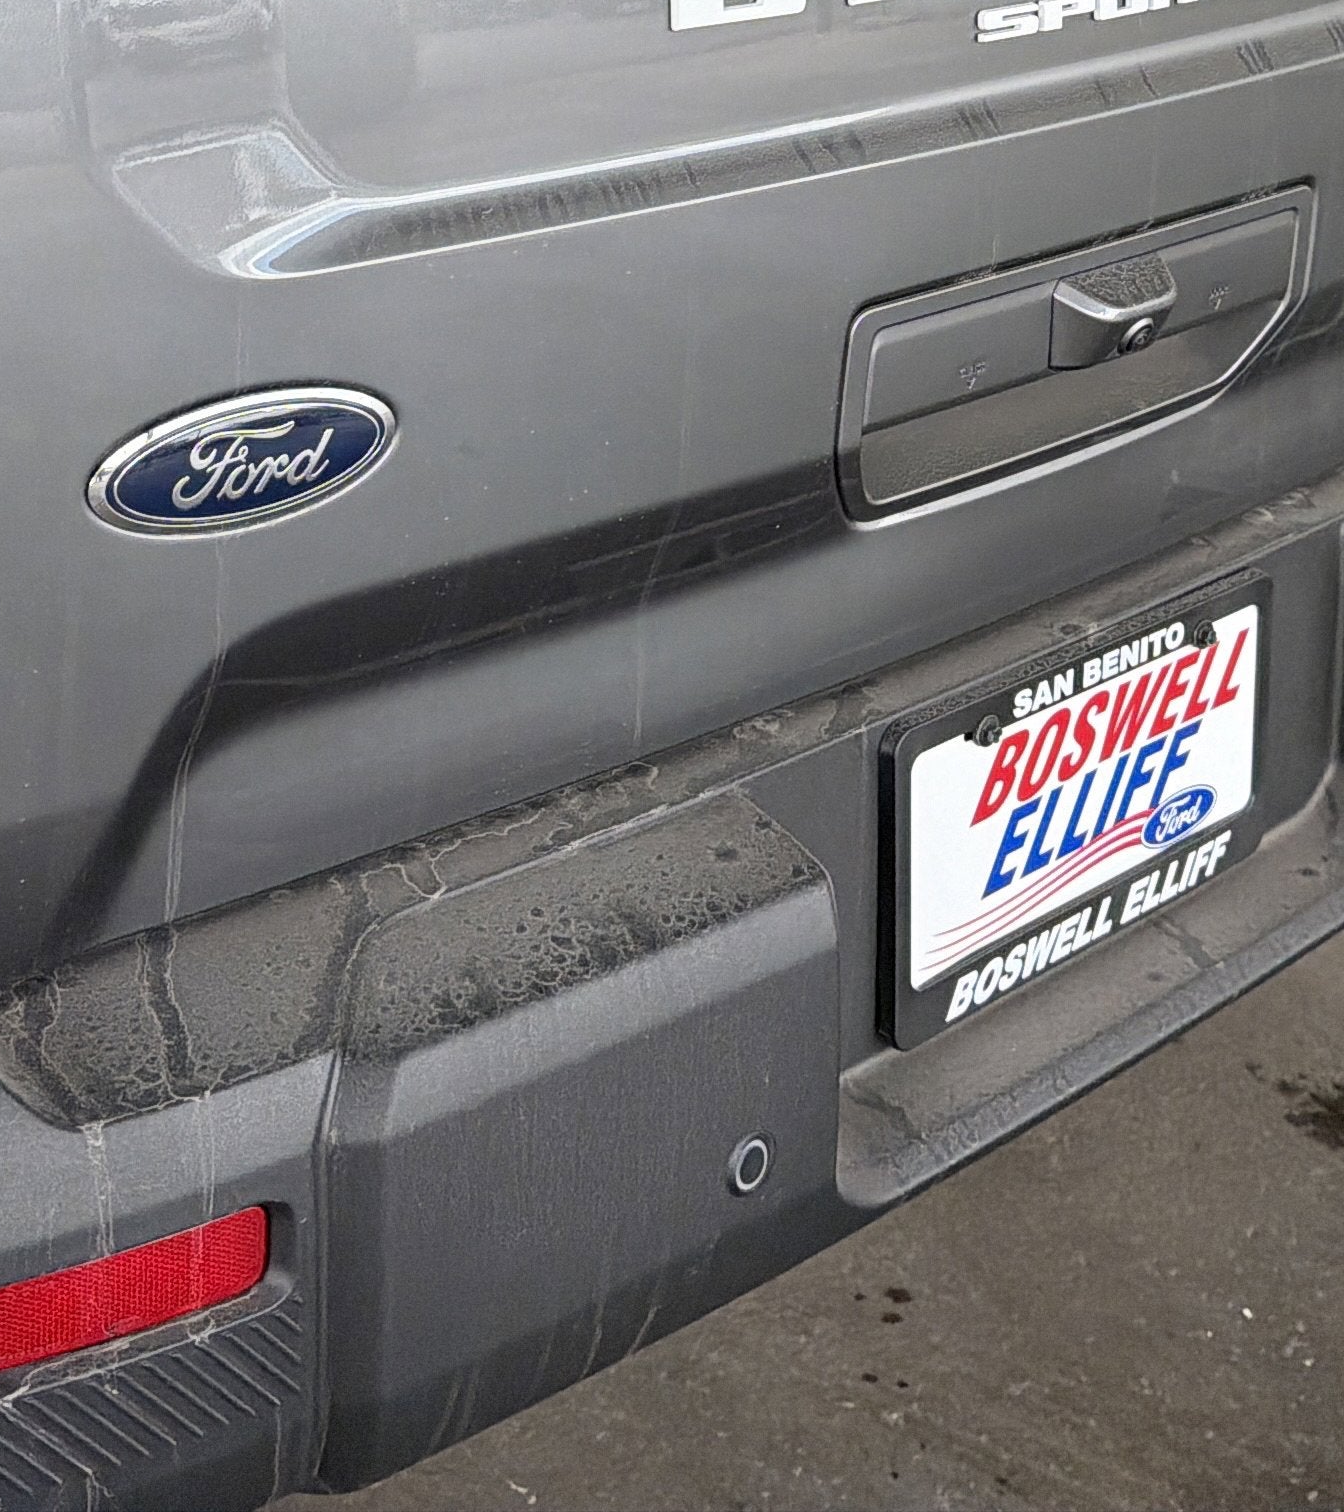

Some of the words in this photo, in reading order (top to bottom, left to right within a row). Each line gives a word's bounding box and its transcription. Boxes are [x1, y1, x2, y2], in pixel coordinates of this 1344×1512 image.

[172, 420, 335, 510] Ford
[969, 627, 1250, 828] BOSWELL
[1012, 668, 1075, 719] SAN
[1082, 621, 1185, 689] BENITO
[981, 719, 1203, 900] ELLIFF
[1155, 795, 1202, 841] Ford
[945, 907, 1113, 1023] BOSWELL
[1119, 830, 1232, 926] ELLIFF
